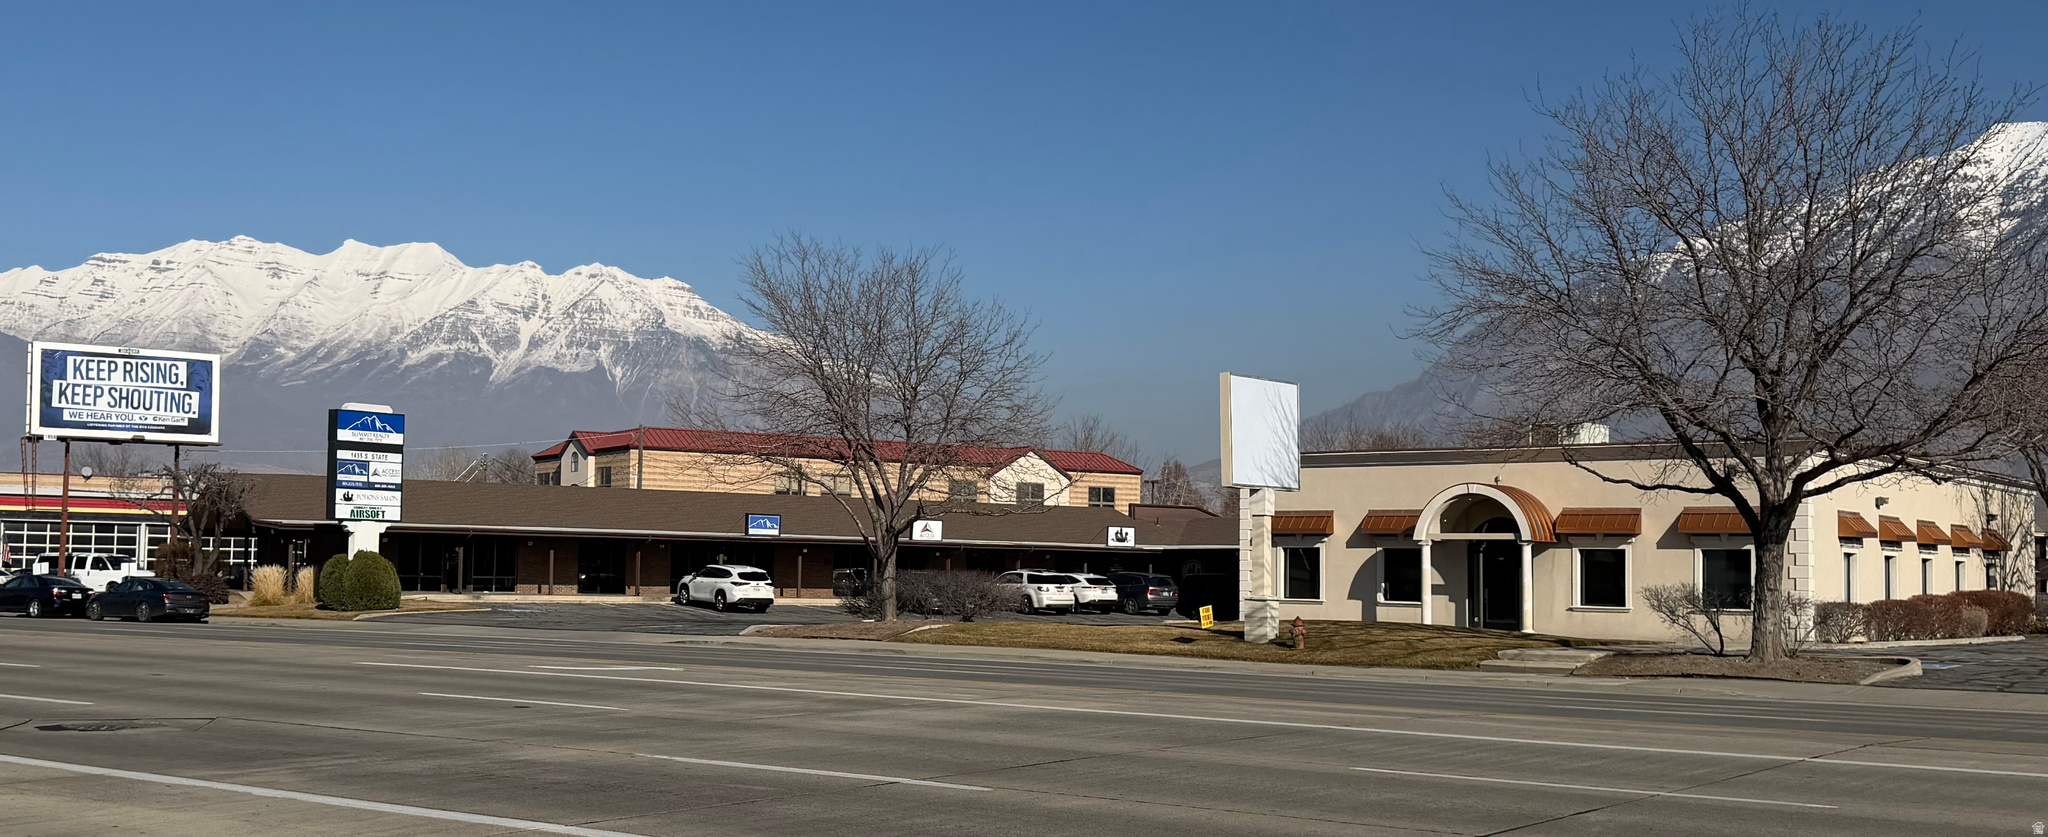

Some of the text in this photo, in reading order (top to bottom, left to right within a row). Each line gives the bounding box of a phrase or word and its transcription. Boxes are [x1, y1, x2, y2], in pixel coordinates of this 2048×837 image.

[73, 358, 184, 386] KEEP RISING.
[58, 382, 196, 415] KEEP SHOUTING.
[68, 411, 136, 422] WE HEAR YOU.
[350, 509, 386, 518] AIRSOFT
